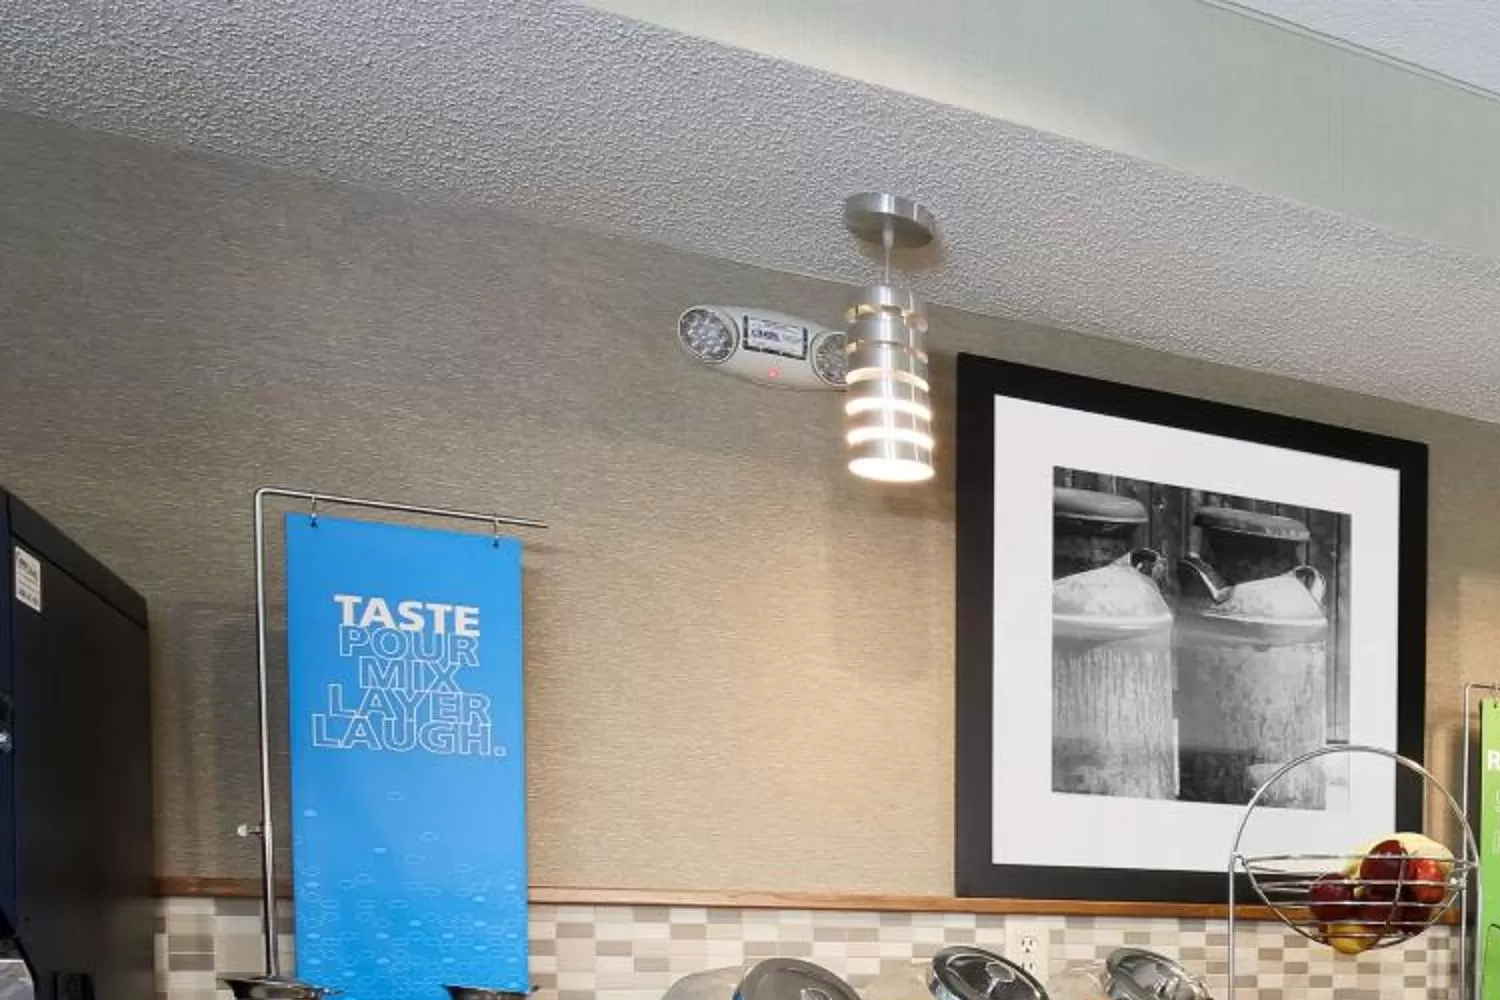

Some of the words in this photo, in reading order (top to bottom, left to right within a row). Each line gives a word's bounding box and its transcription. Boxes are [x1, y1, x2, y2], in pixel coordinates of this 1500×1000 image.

[334, 595, 480, 637] TASTE
[339, 624, 480, 666] POUR
[359, 656, 460, 693] MIX
[328, 683, 492, 727] LAYER
[312, 713, 507, 757] LAUGH.
